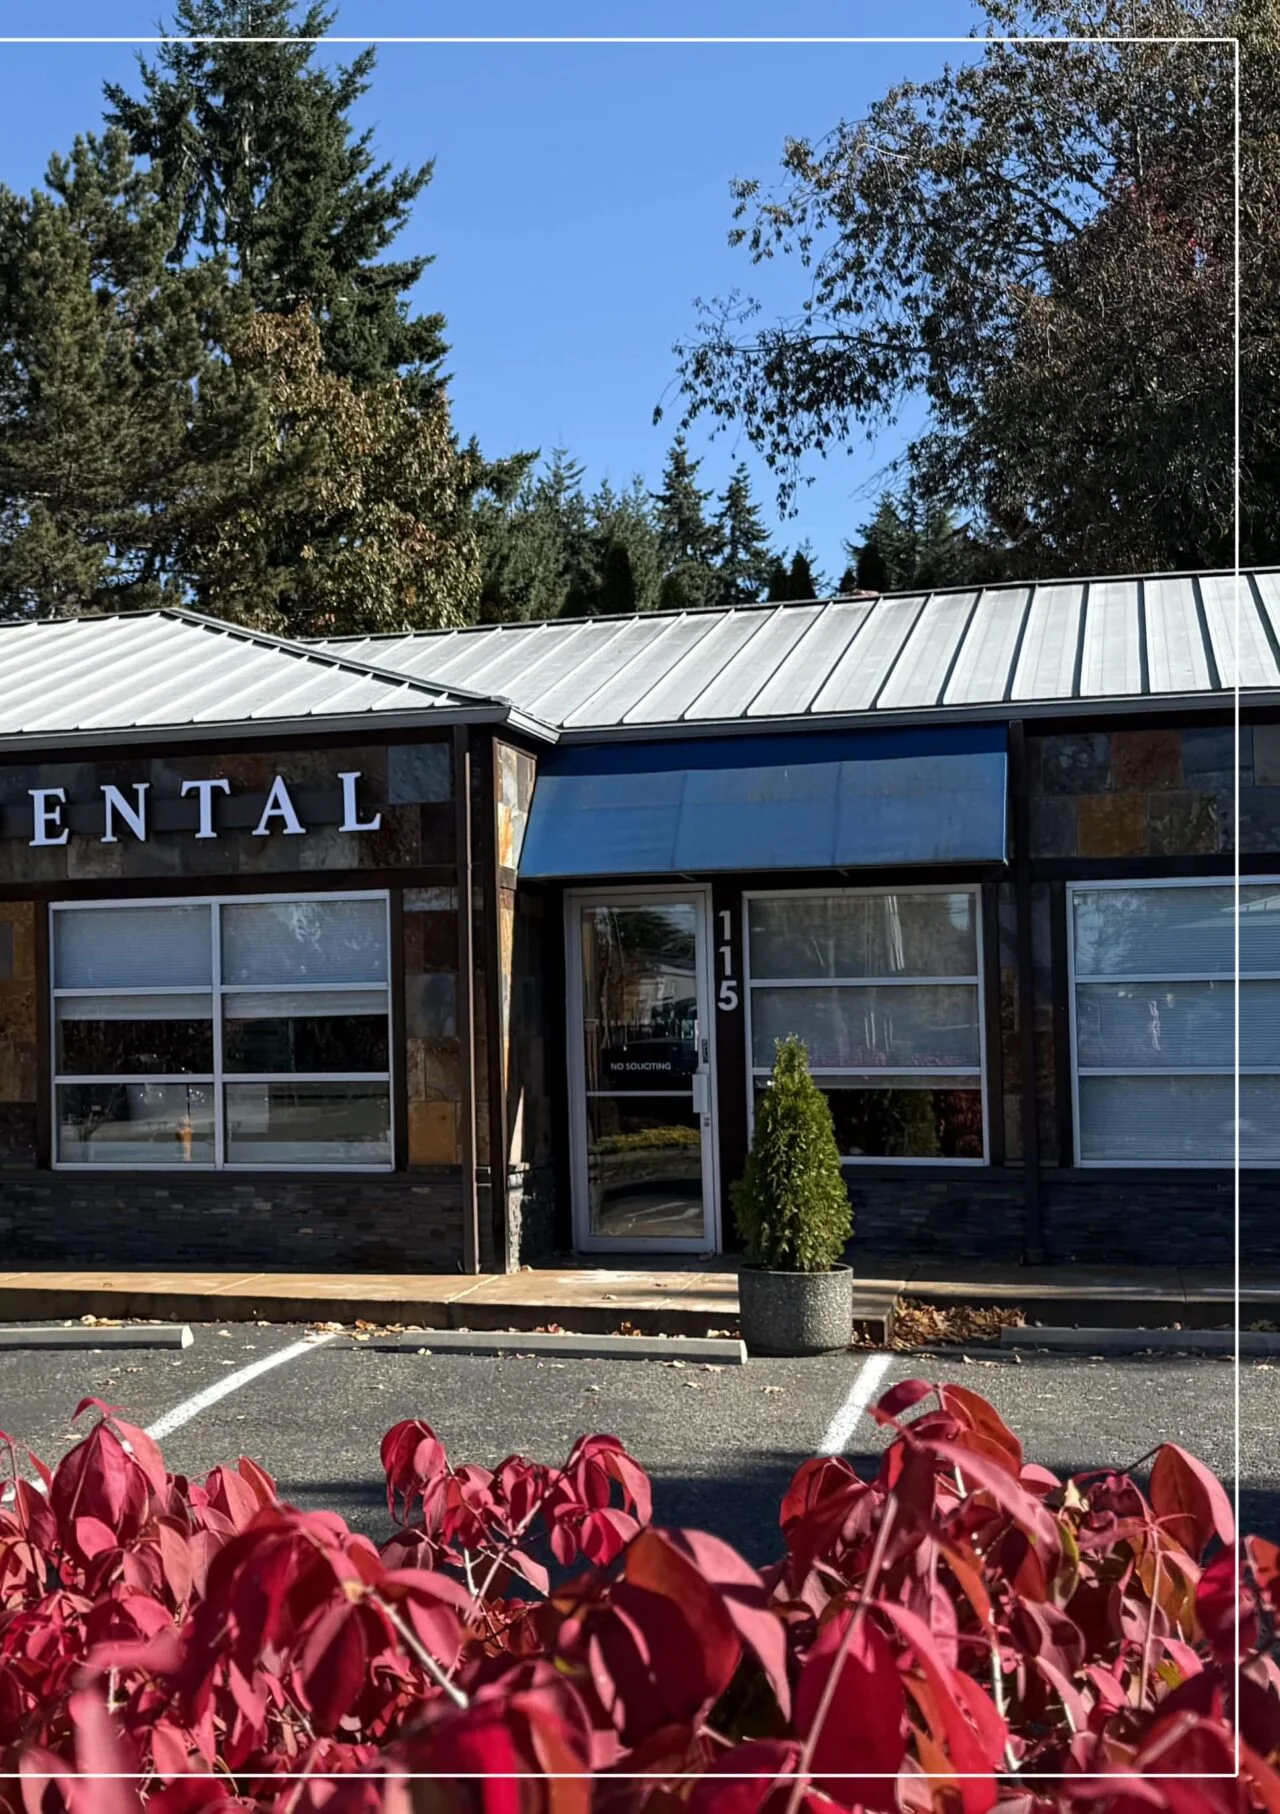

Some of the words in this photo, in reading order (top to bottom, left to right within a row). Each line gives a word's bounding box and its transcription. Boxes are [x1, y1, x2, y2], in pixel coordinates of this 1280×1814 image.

[717, 909, 739, 1012] 115
[610, 1062, 624, 1071] NO
[625, 1061, 671, 1071] SOLICITING
